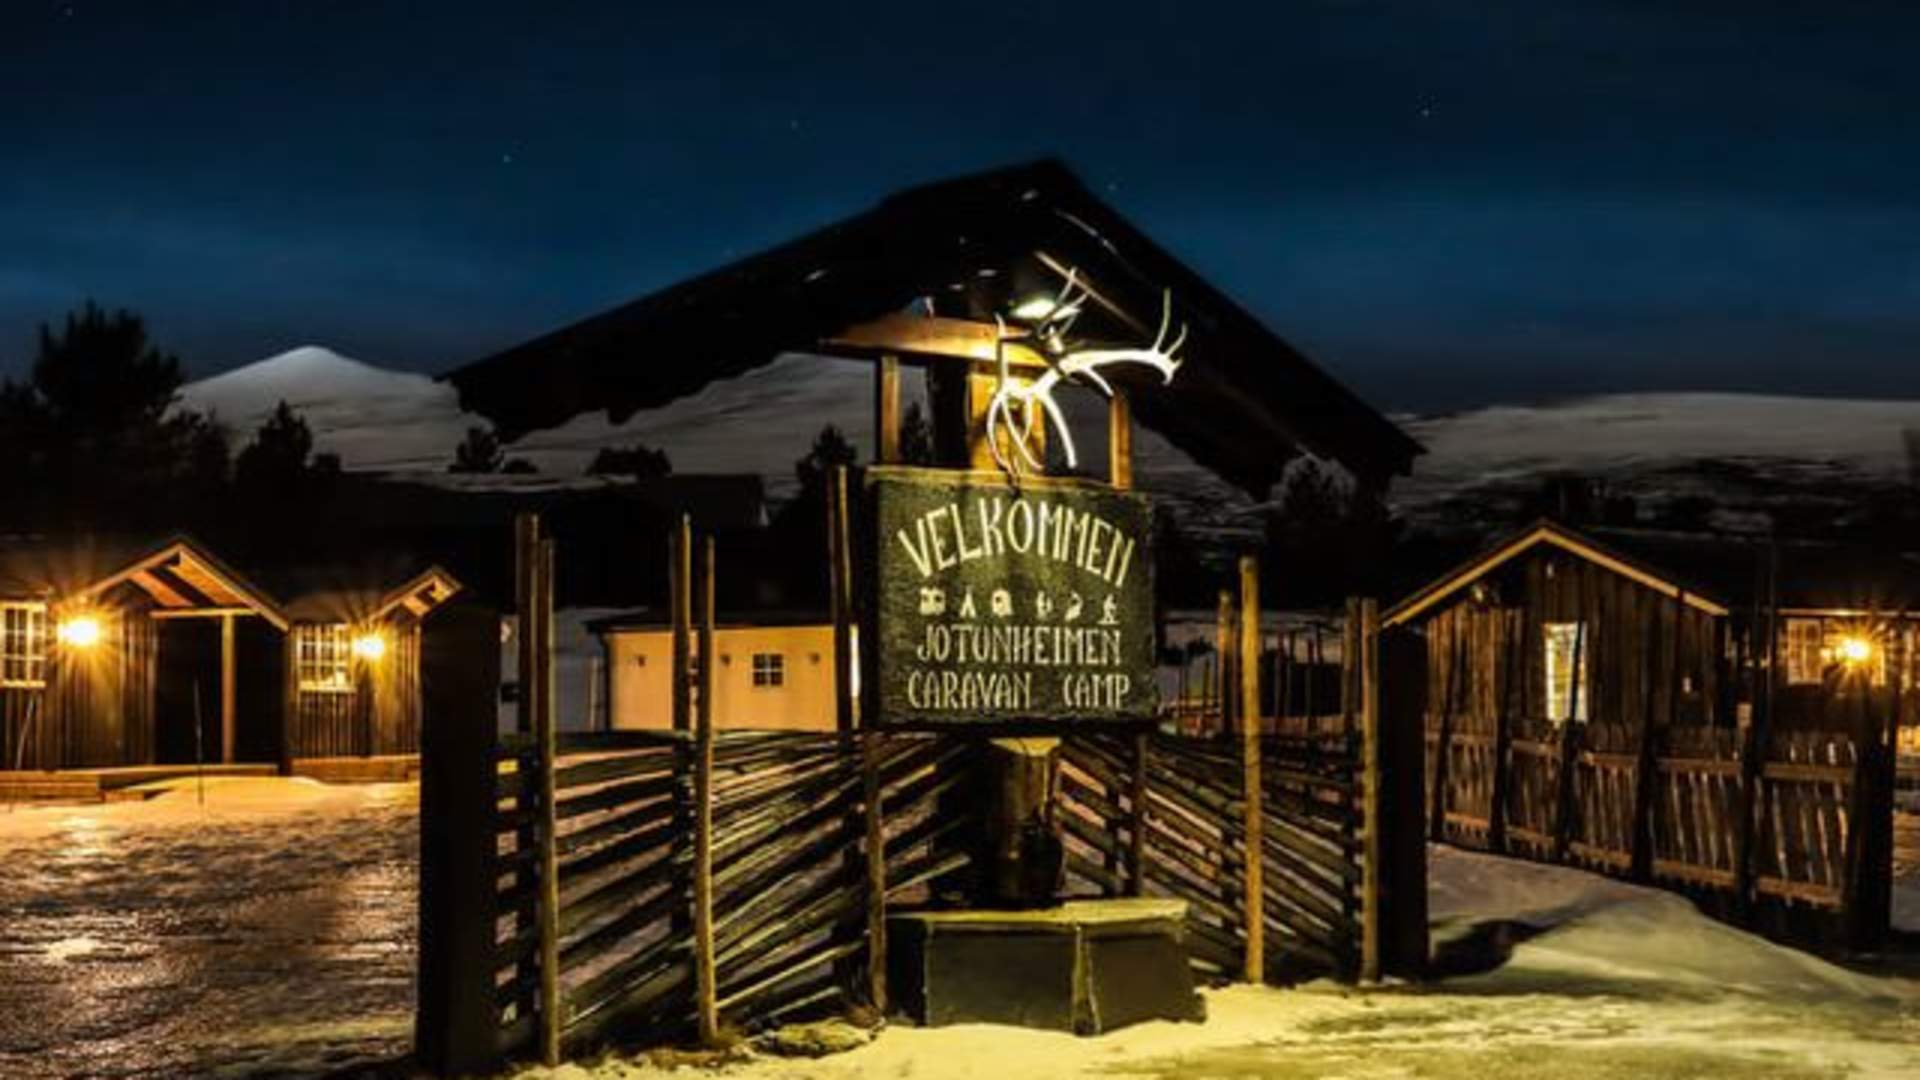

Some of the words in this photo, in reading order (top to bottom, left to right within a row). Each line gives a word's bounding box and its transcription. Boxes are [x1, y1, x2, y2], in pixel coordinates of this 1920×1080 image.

[898, 498, 1135, 588] VELKOMMEN
[917, 624, 1121, 665] JOTUNHEIMEN
[908, 670, 1032, 709] CARAVAN
[1063, 674, 1130, 709] CAMP
